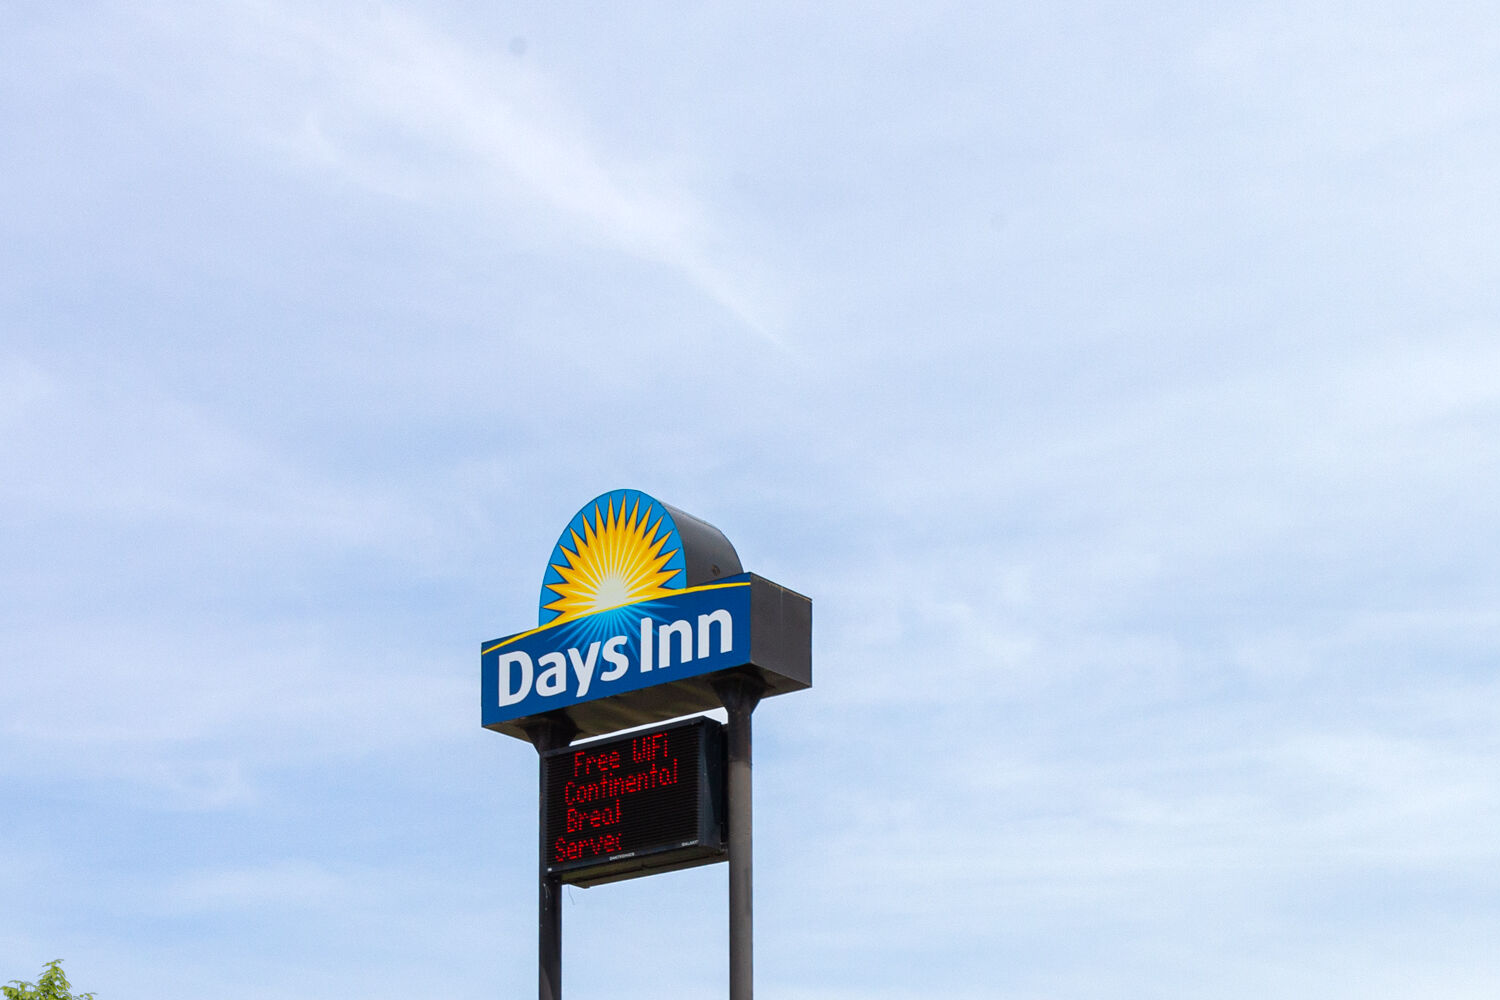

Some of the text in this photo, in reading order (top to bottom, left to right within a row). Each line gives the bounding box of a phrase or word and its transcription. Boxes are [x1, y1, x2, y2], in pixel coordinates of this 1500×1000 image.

[498, 608, 733, 708] Days Inn
[574, 732, 668, 777] Free WiFi
[565, 758, 678, 806] Continental
